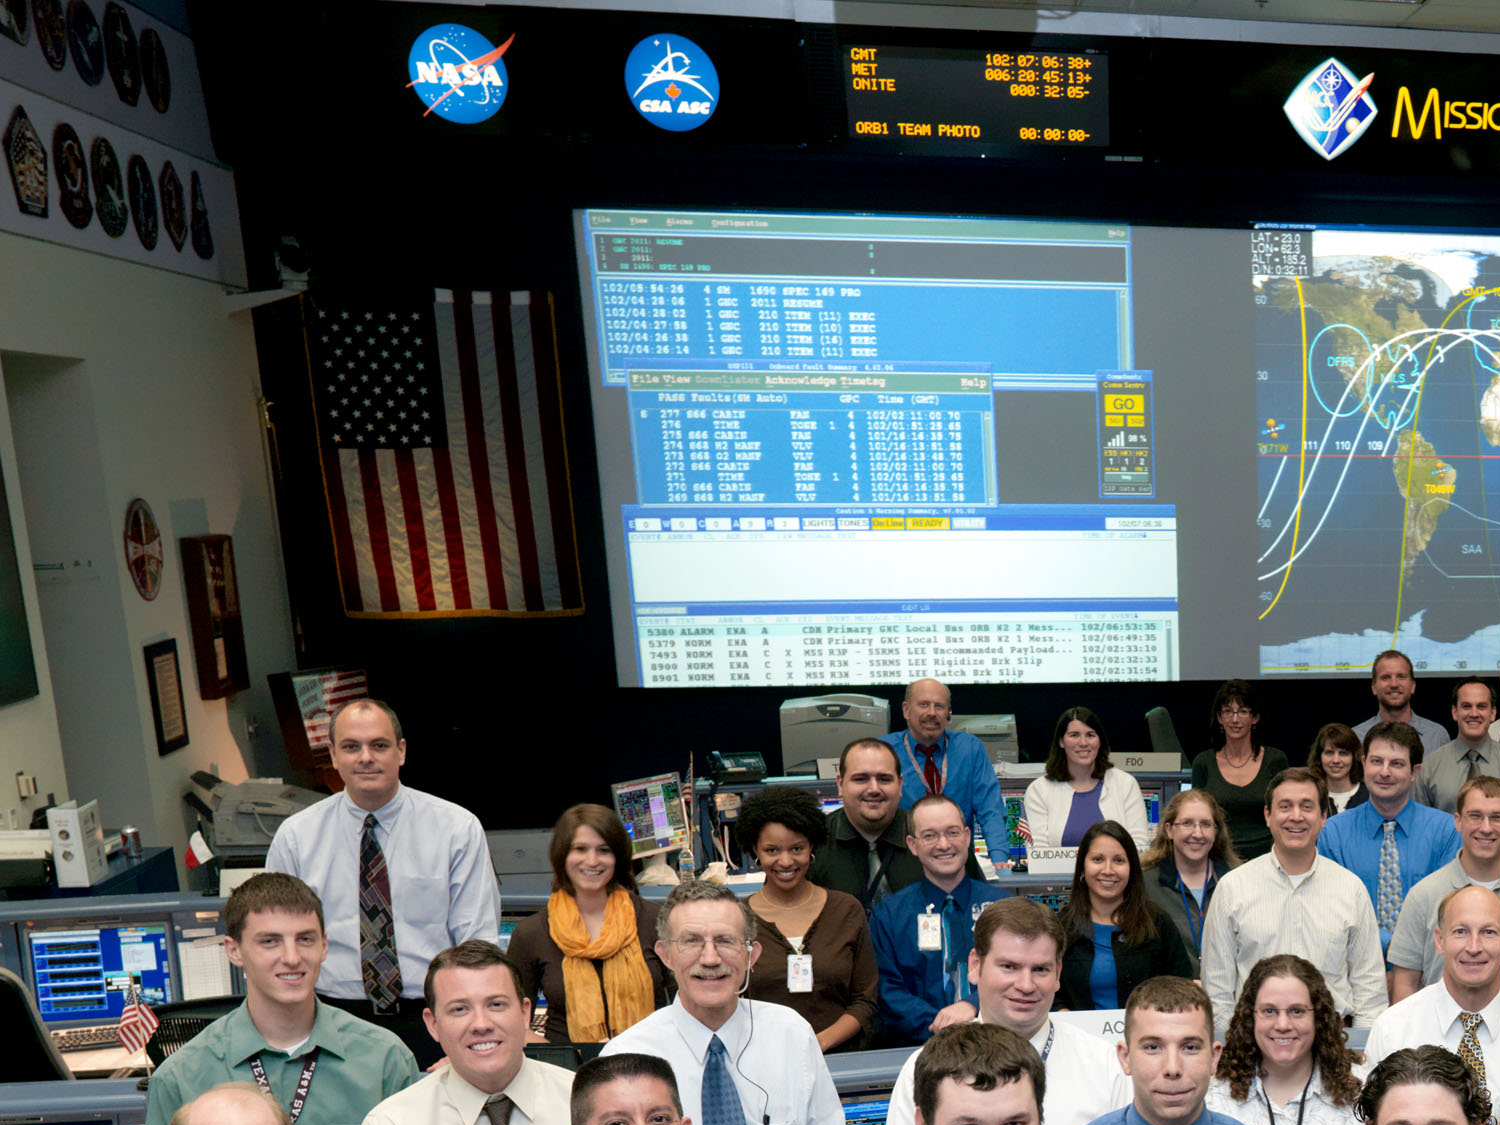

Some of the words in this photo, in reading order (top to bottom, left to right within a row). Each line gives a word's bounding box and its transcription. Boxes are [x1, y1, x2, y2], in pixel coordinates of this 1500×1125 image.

[851, 48, 877, 60] GMT
[416, 61, 502, 88] NASA
[852, 63, 878, 76] MET
[853, 79, 896, 91] ONITE
[640, 100, 671, 114] CSA
[678, 101, 710, 114] ASC
[856, 122, 888, 134] ORB1
[897, 123, 931, 136] TEAM
[938, 125, 980, 138] PHOTO
[1251, 232, 1271, 242] LAT
[1252, 254, 1272, 264] ALT
[632, 375, 659, 383] File
[1113, 398, 1134, 409] GO
[1461, 544, 1482, 555] SAA
[680, 628, 714, 636] ALARM
[827, 626, 872, 635] Primary
[906, 624, 937, 632] Local
[1126, 758, 1143, 766] FDO
[251, 1059, 272, 1097] TEXA
[297, 1070, 312, 1096] A&M
